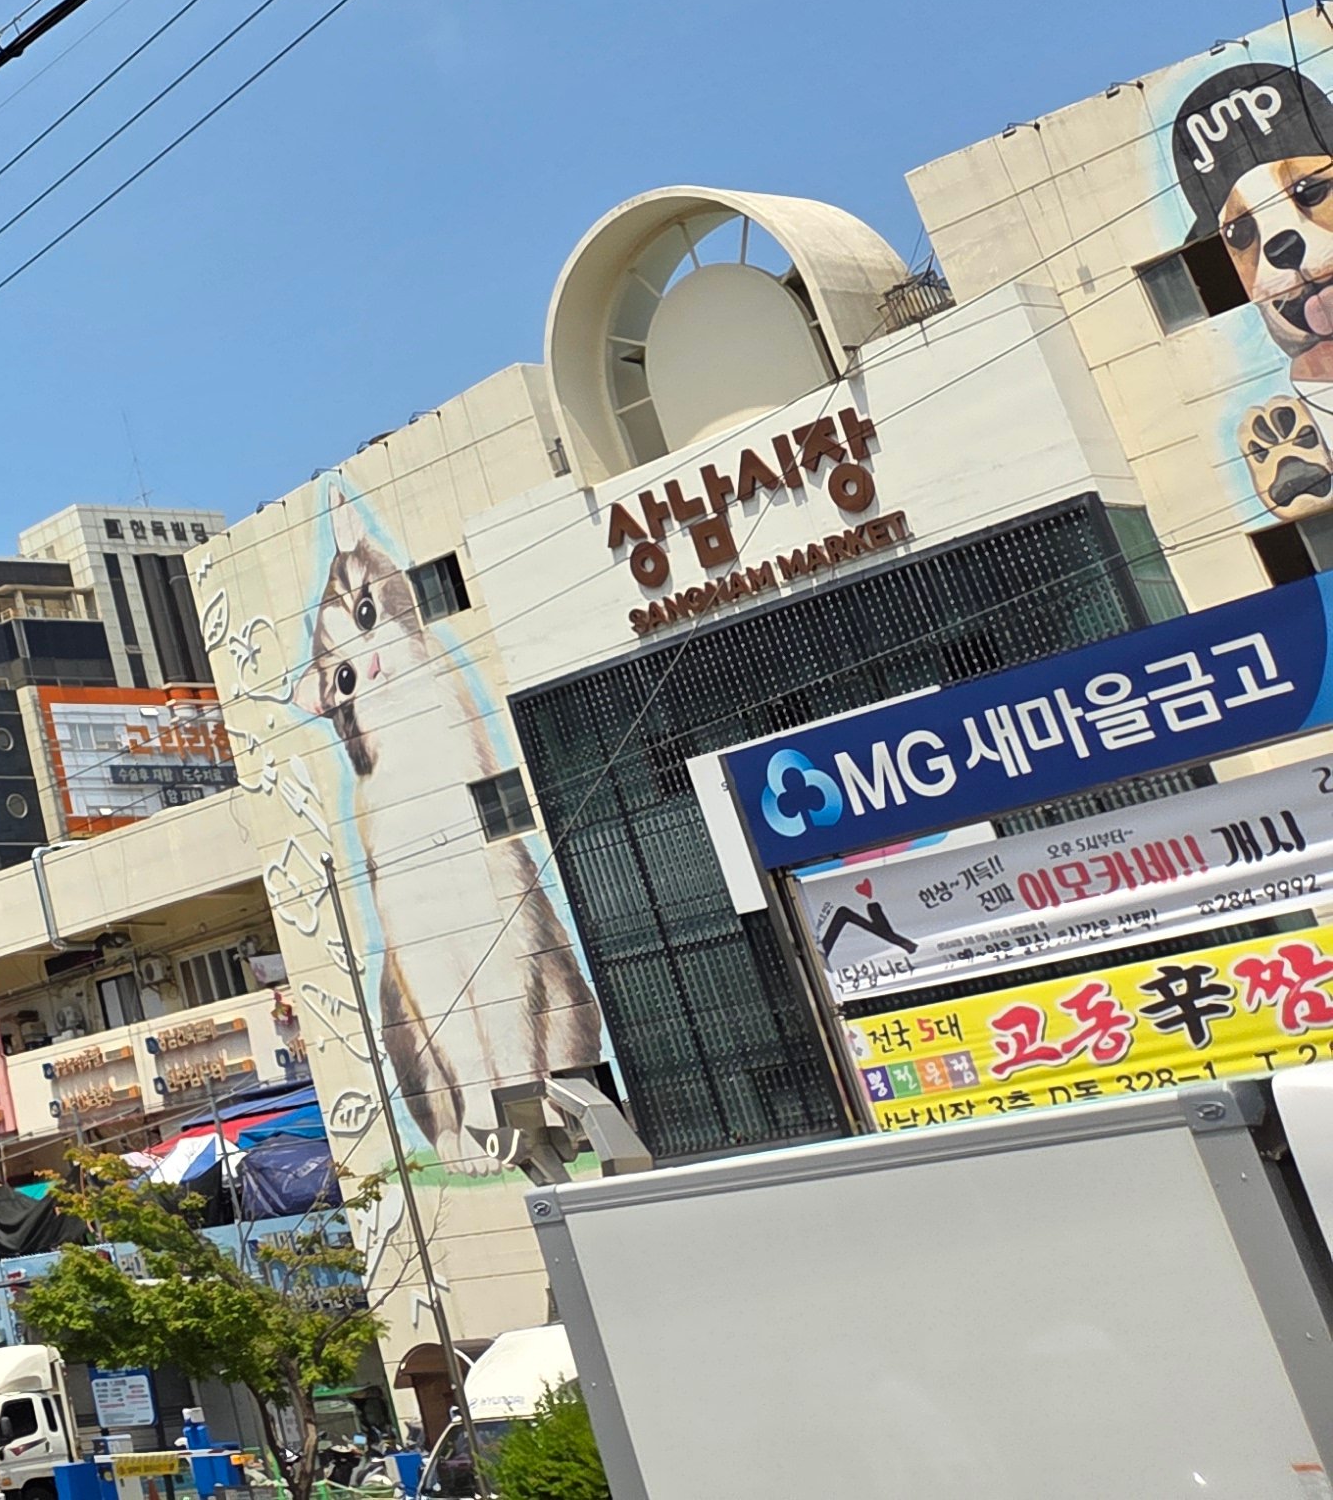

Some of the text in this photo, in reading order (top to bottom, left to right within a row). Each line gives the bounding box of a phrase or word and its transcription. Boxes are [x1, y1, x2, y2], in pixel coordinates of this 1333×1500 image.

[608, 407, 876, 588] 상남시장
[628, 509, 907, 635] SANGNAM MARKET
[1016, 833, 1209, 912] 이모카세!!
[1210, 809, 1307, 867] 개시
[1213, 873, 1323, 915] 284-9992
[867, 1012, 964, 1054] 전국 5대
